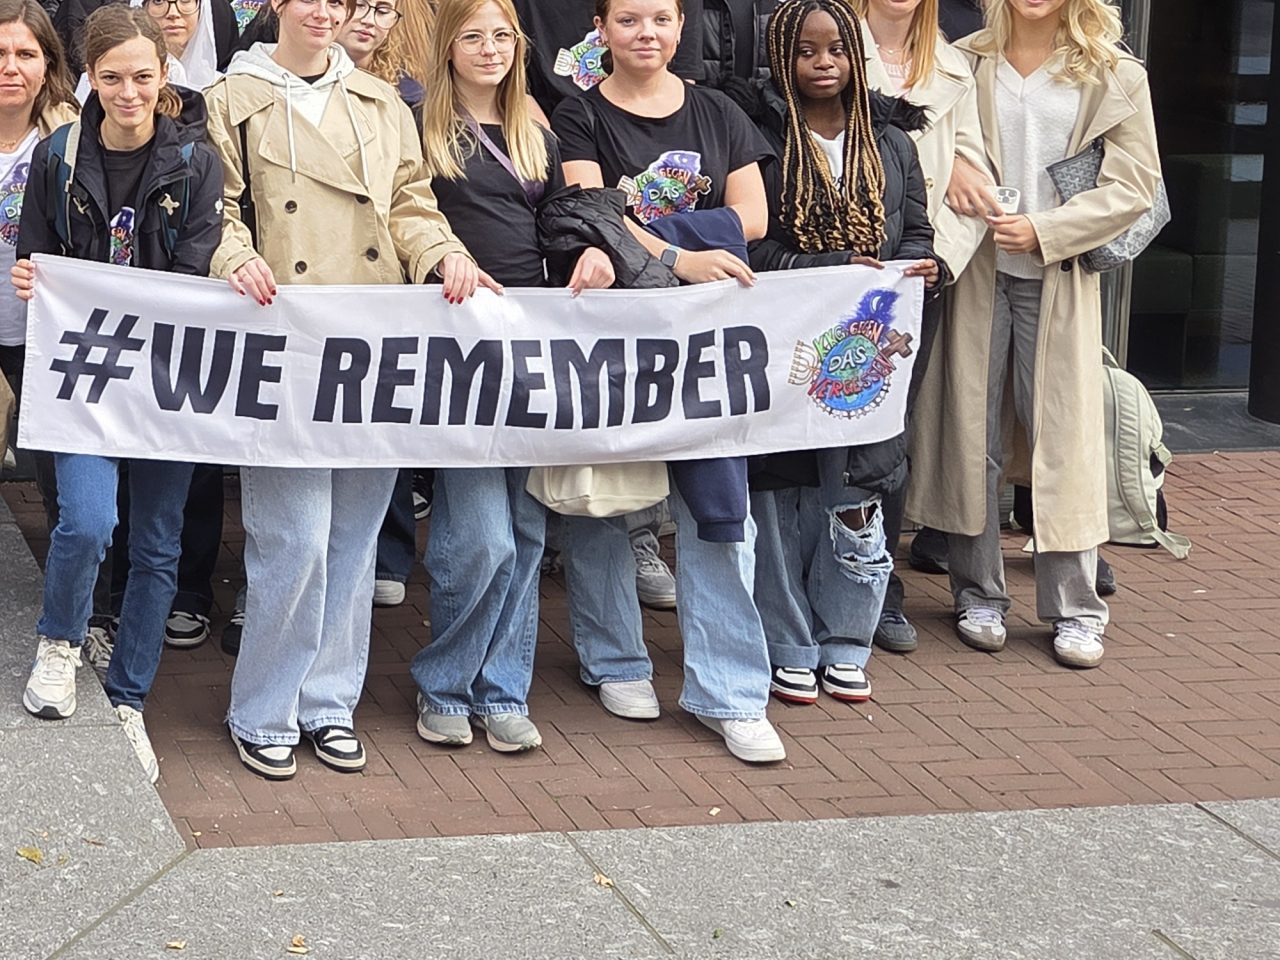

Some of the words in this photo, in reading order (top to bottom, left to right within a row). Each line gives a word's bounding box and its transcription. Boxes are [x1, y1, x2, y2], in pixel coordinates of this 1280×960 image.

[659, 167, 692, 186] GEGEN
[648, 186, 680, 201] DAS
[849, 319, 884, 346] GEGEN
[48, 307, 287, 420] #WE
[312, 325, 771, 429] REMEMBER
[827, 345, 868, 373] DAS
